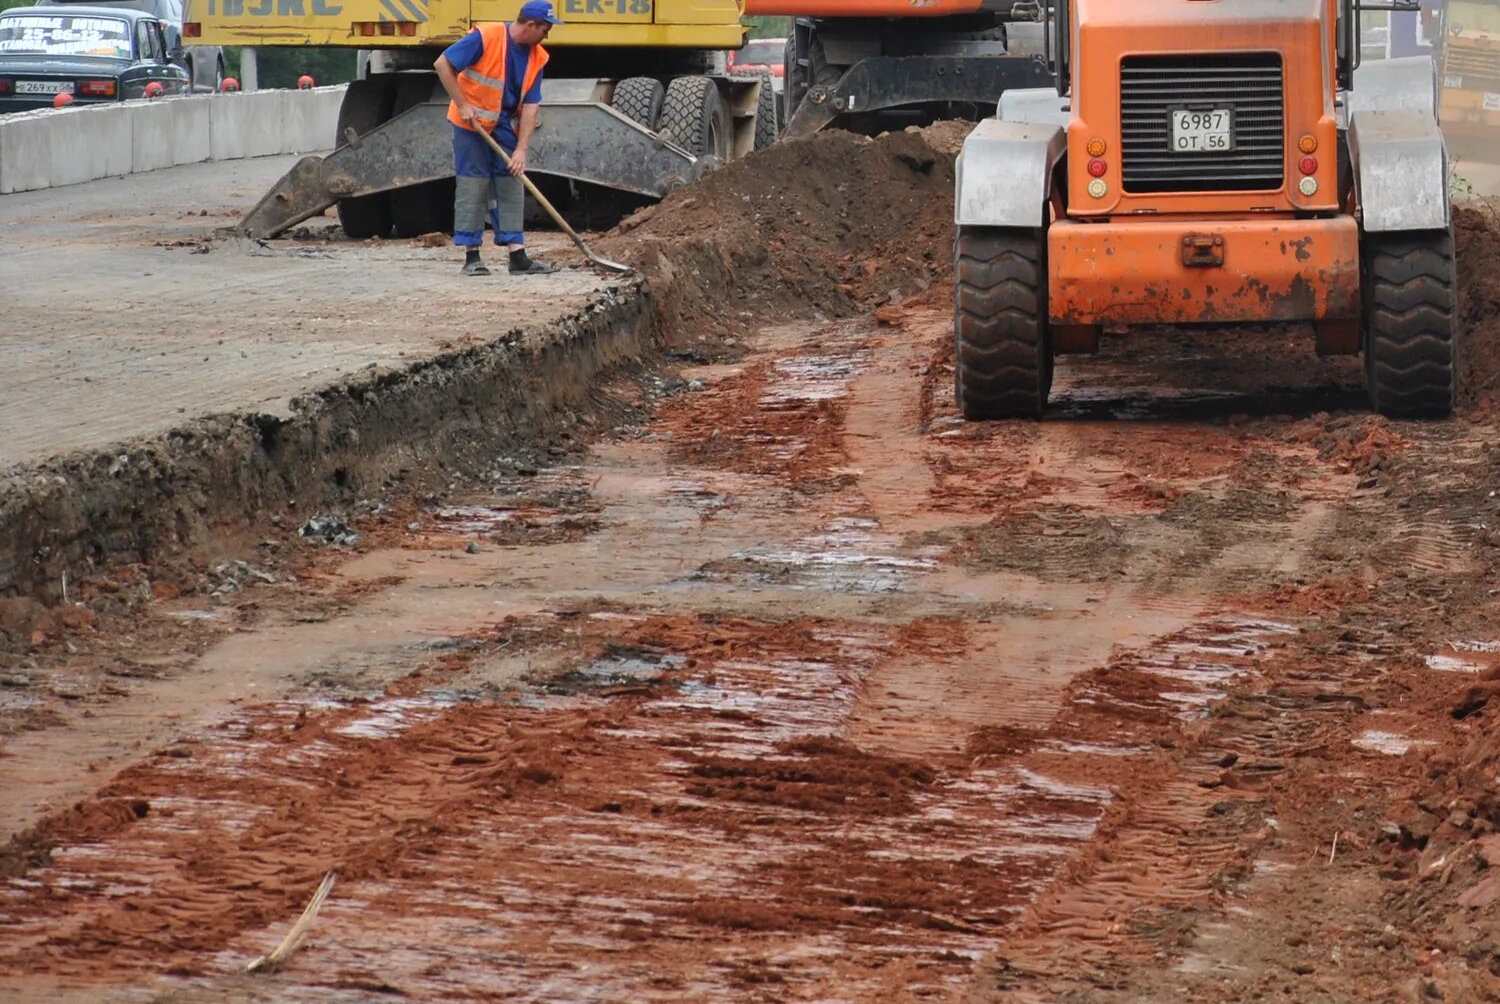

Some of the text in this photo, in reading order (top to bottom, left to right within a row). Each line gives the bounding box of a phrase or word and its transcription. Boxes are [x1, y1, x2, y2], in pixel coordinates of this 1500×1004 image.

[1180, 114, 1222, 130] 6987
[1178, 136, 1225, 148] ОТ 56
